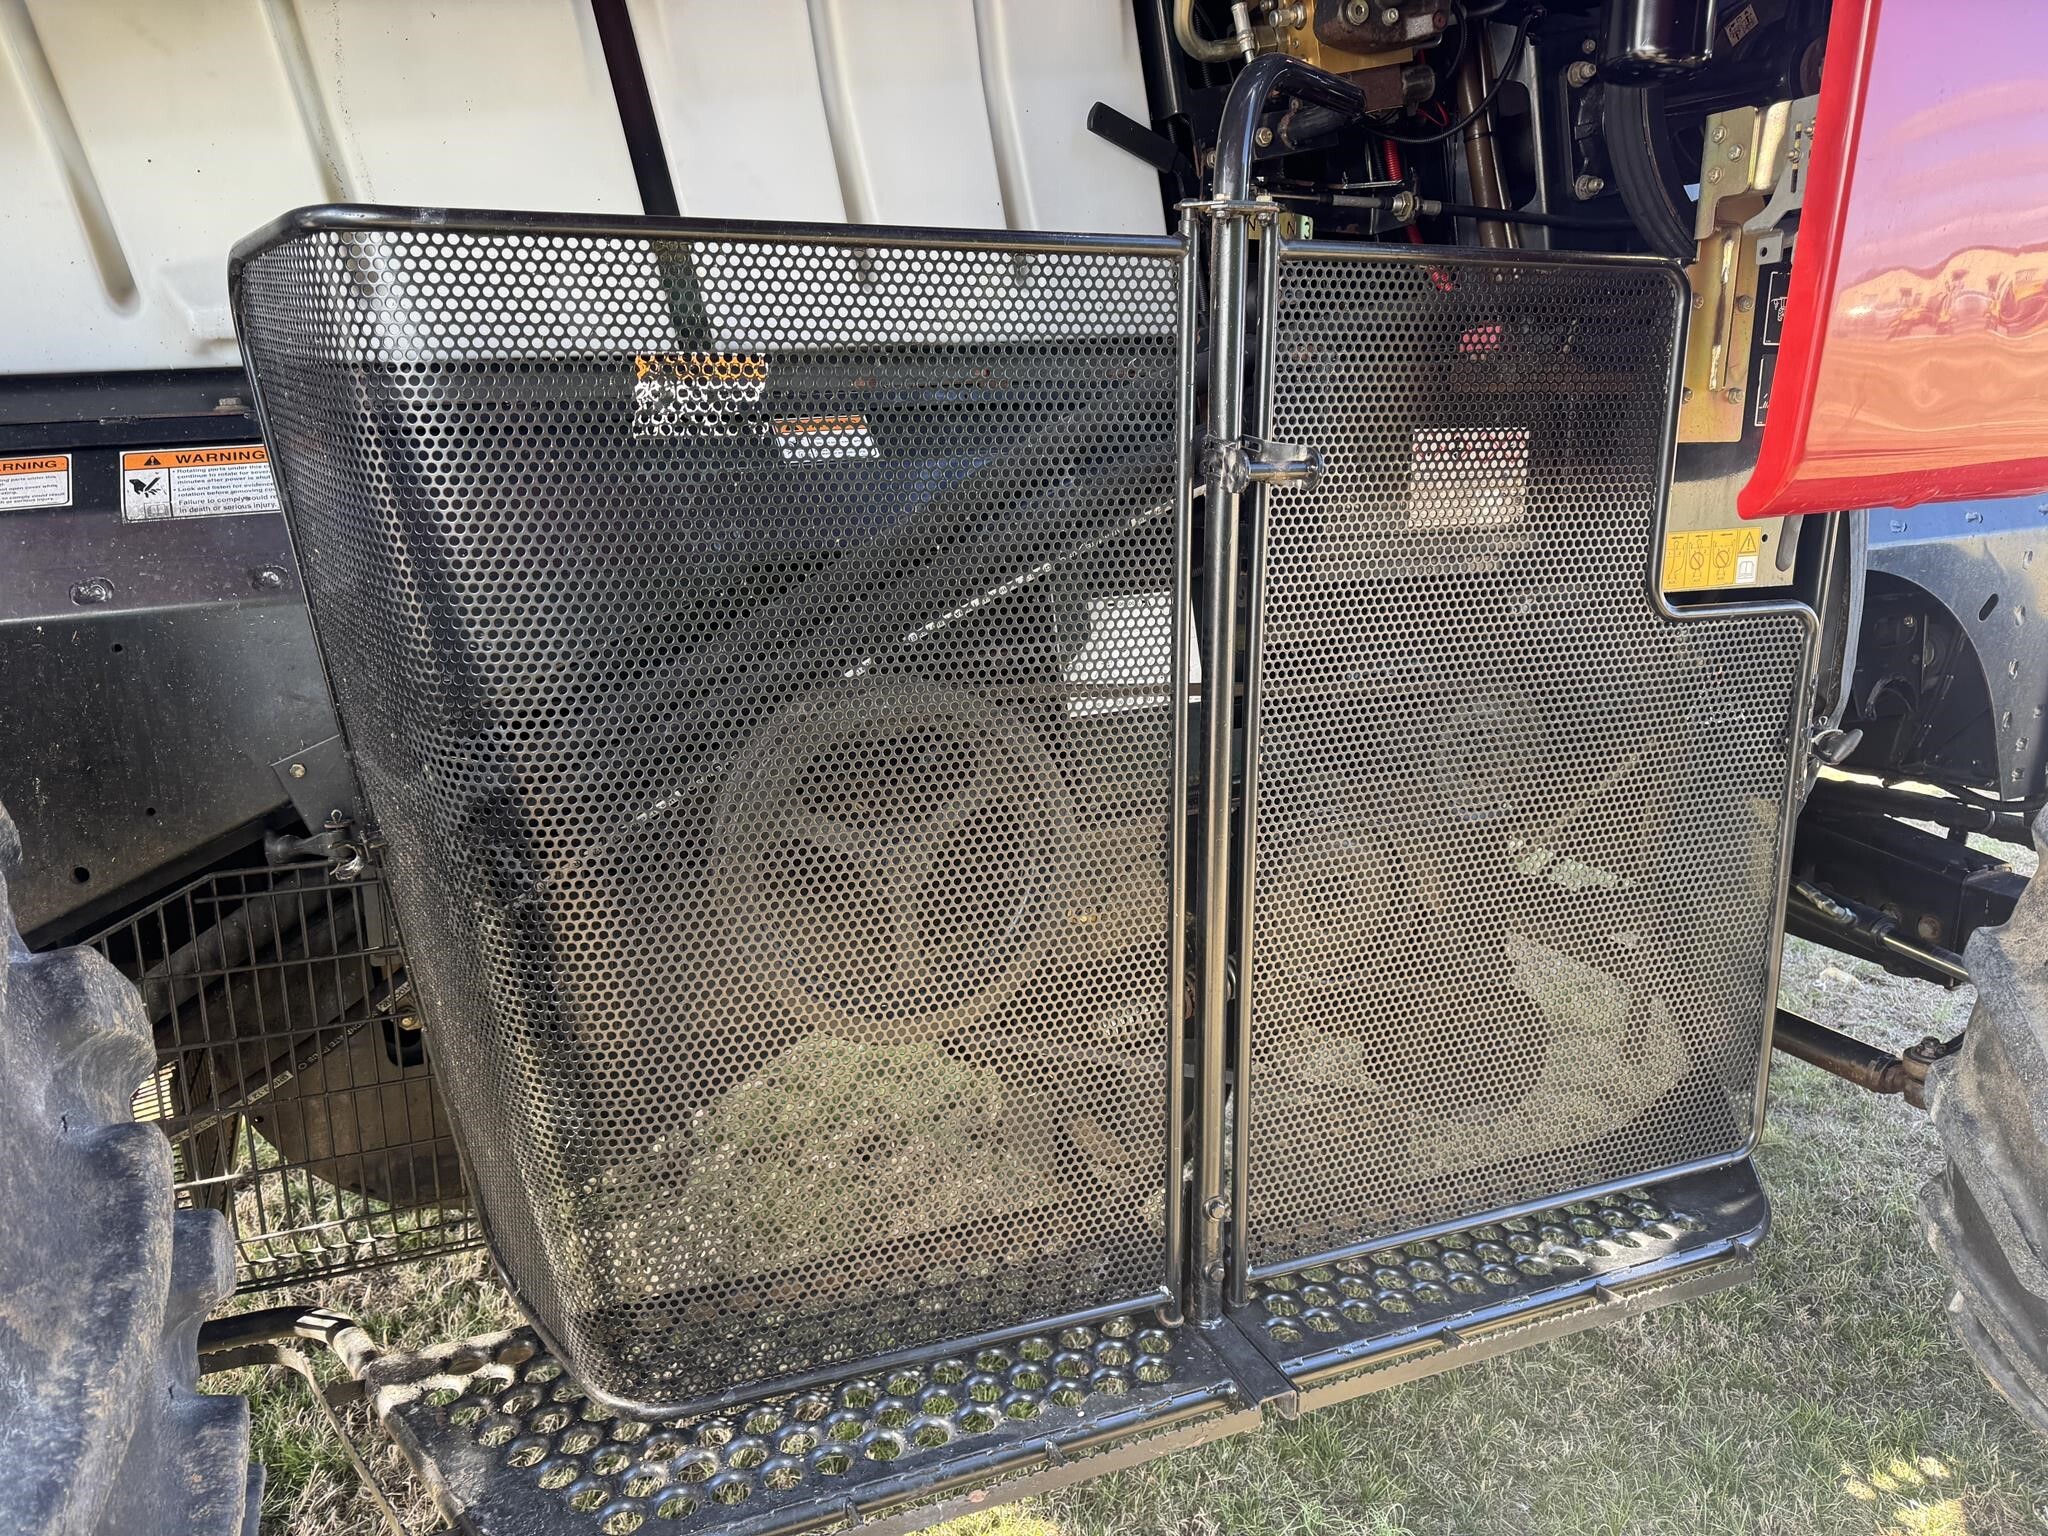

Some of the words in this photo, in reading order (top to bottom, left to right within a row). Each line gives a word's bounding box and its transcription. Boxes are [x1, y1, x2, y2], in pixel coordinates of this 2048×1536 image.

[175, 450, 265, 463] WARNING
[0, 461, 57, 471] RNING
[179, 498, 205, 506] Failure
[217, 496, 244, 504] comply
[189, 505, 210, 513] death
[223, 503, 252, 511] serious
